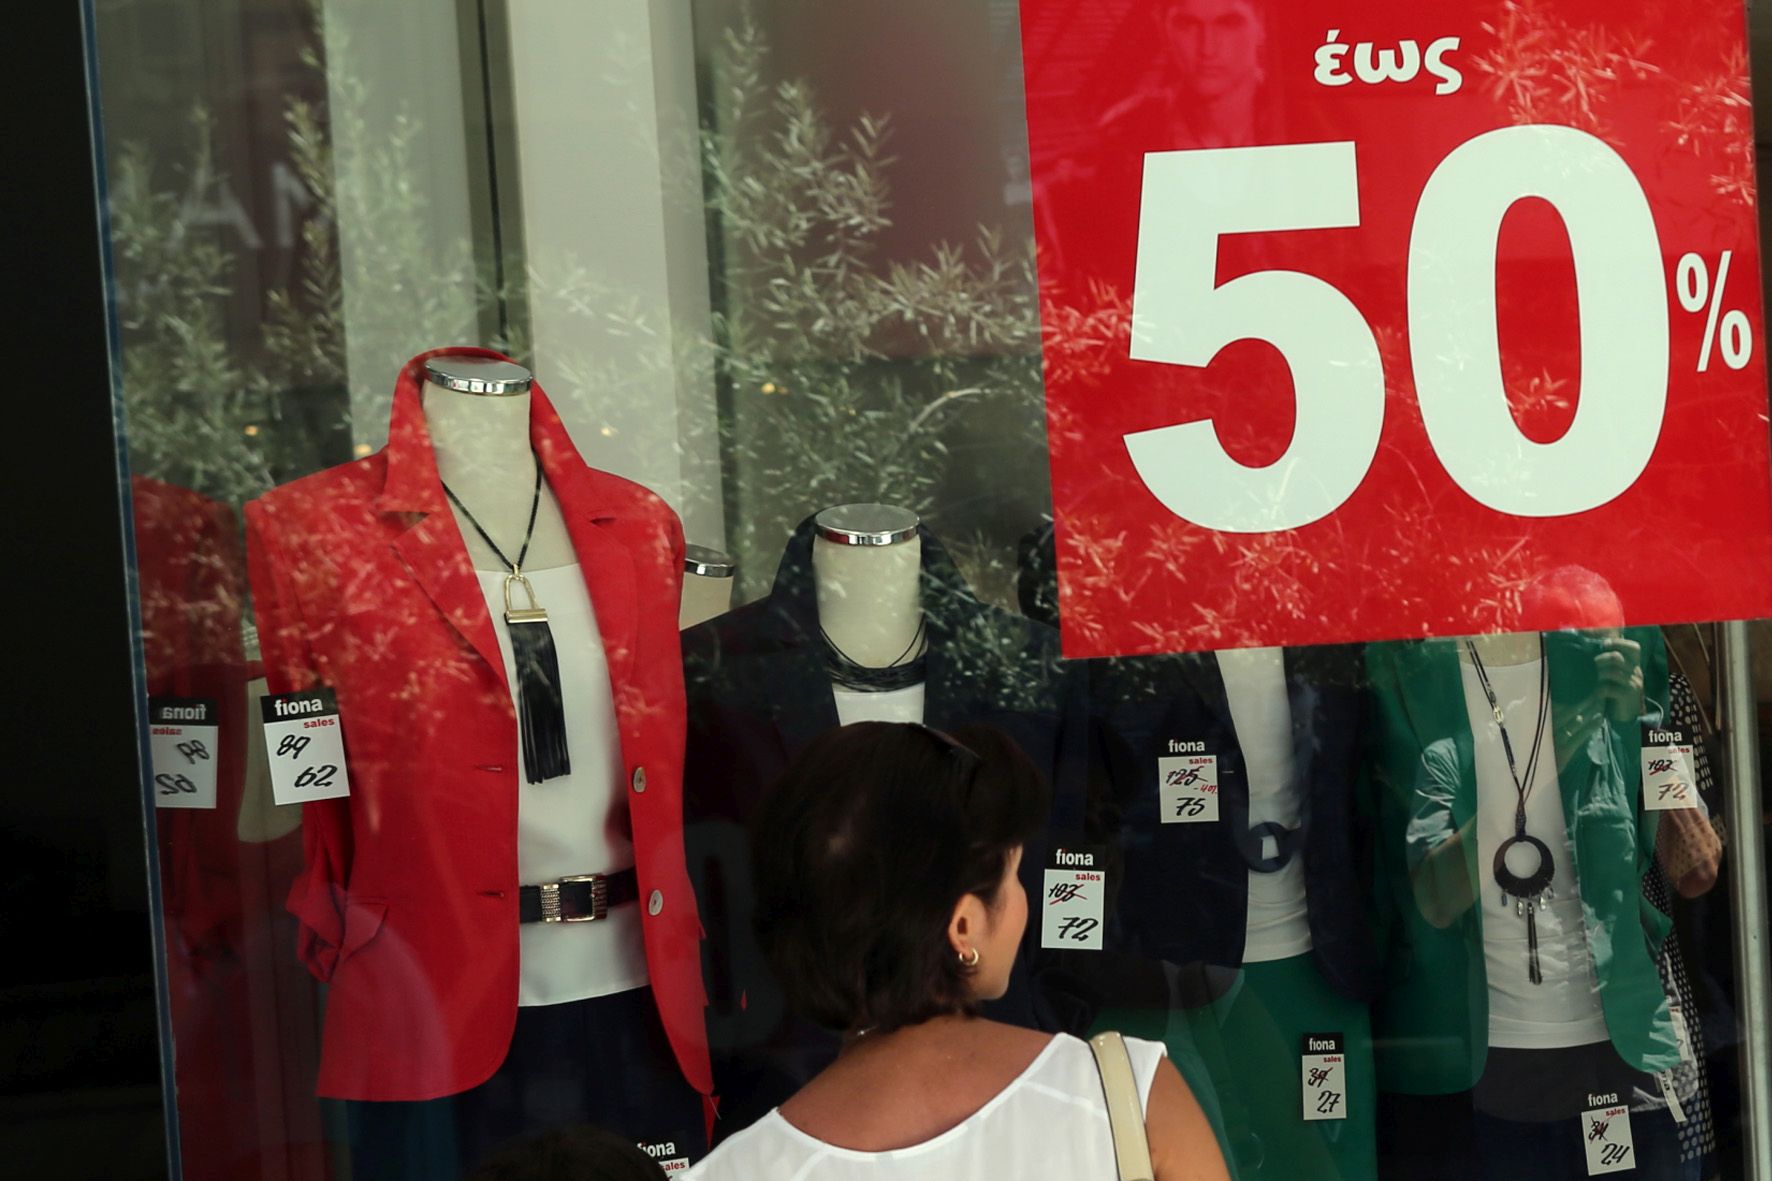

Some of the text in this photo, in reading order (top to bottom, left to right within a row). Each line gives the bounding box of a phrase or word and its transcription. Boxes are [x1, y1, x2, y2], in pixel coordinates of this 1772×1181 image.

[1314, 29, 1463, 95] έως
[275, 698, 323, 716] fiona
[304, 718, 335, 728] sales
[1168, 738, 1205, 752] fiona
[1649, 730, 1682, 742] fiona
[277, 735, 311, 759] 89
[295, 765, 337, 787] 62
[1658, 783, 1689, 801] 72
[1176, 797, 1206, 816] 75
[1056, 848, 1094, 866] fiona
[1058, 917, 1099, 941] 72
[1309, 1038, 1336, 1051] fiona
[1317, 1090, 1341, 1113] 27
[1587, 1093, 1618, 1107] fiona
[1605, 1108, 1626, 1117] sales
[1601, 1143, 1630, 1165] 24
[663, 1161, 686, 1171] ales
